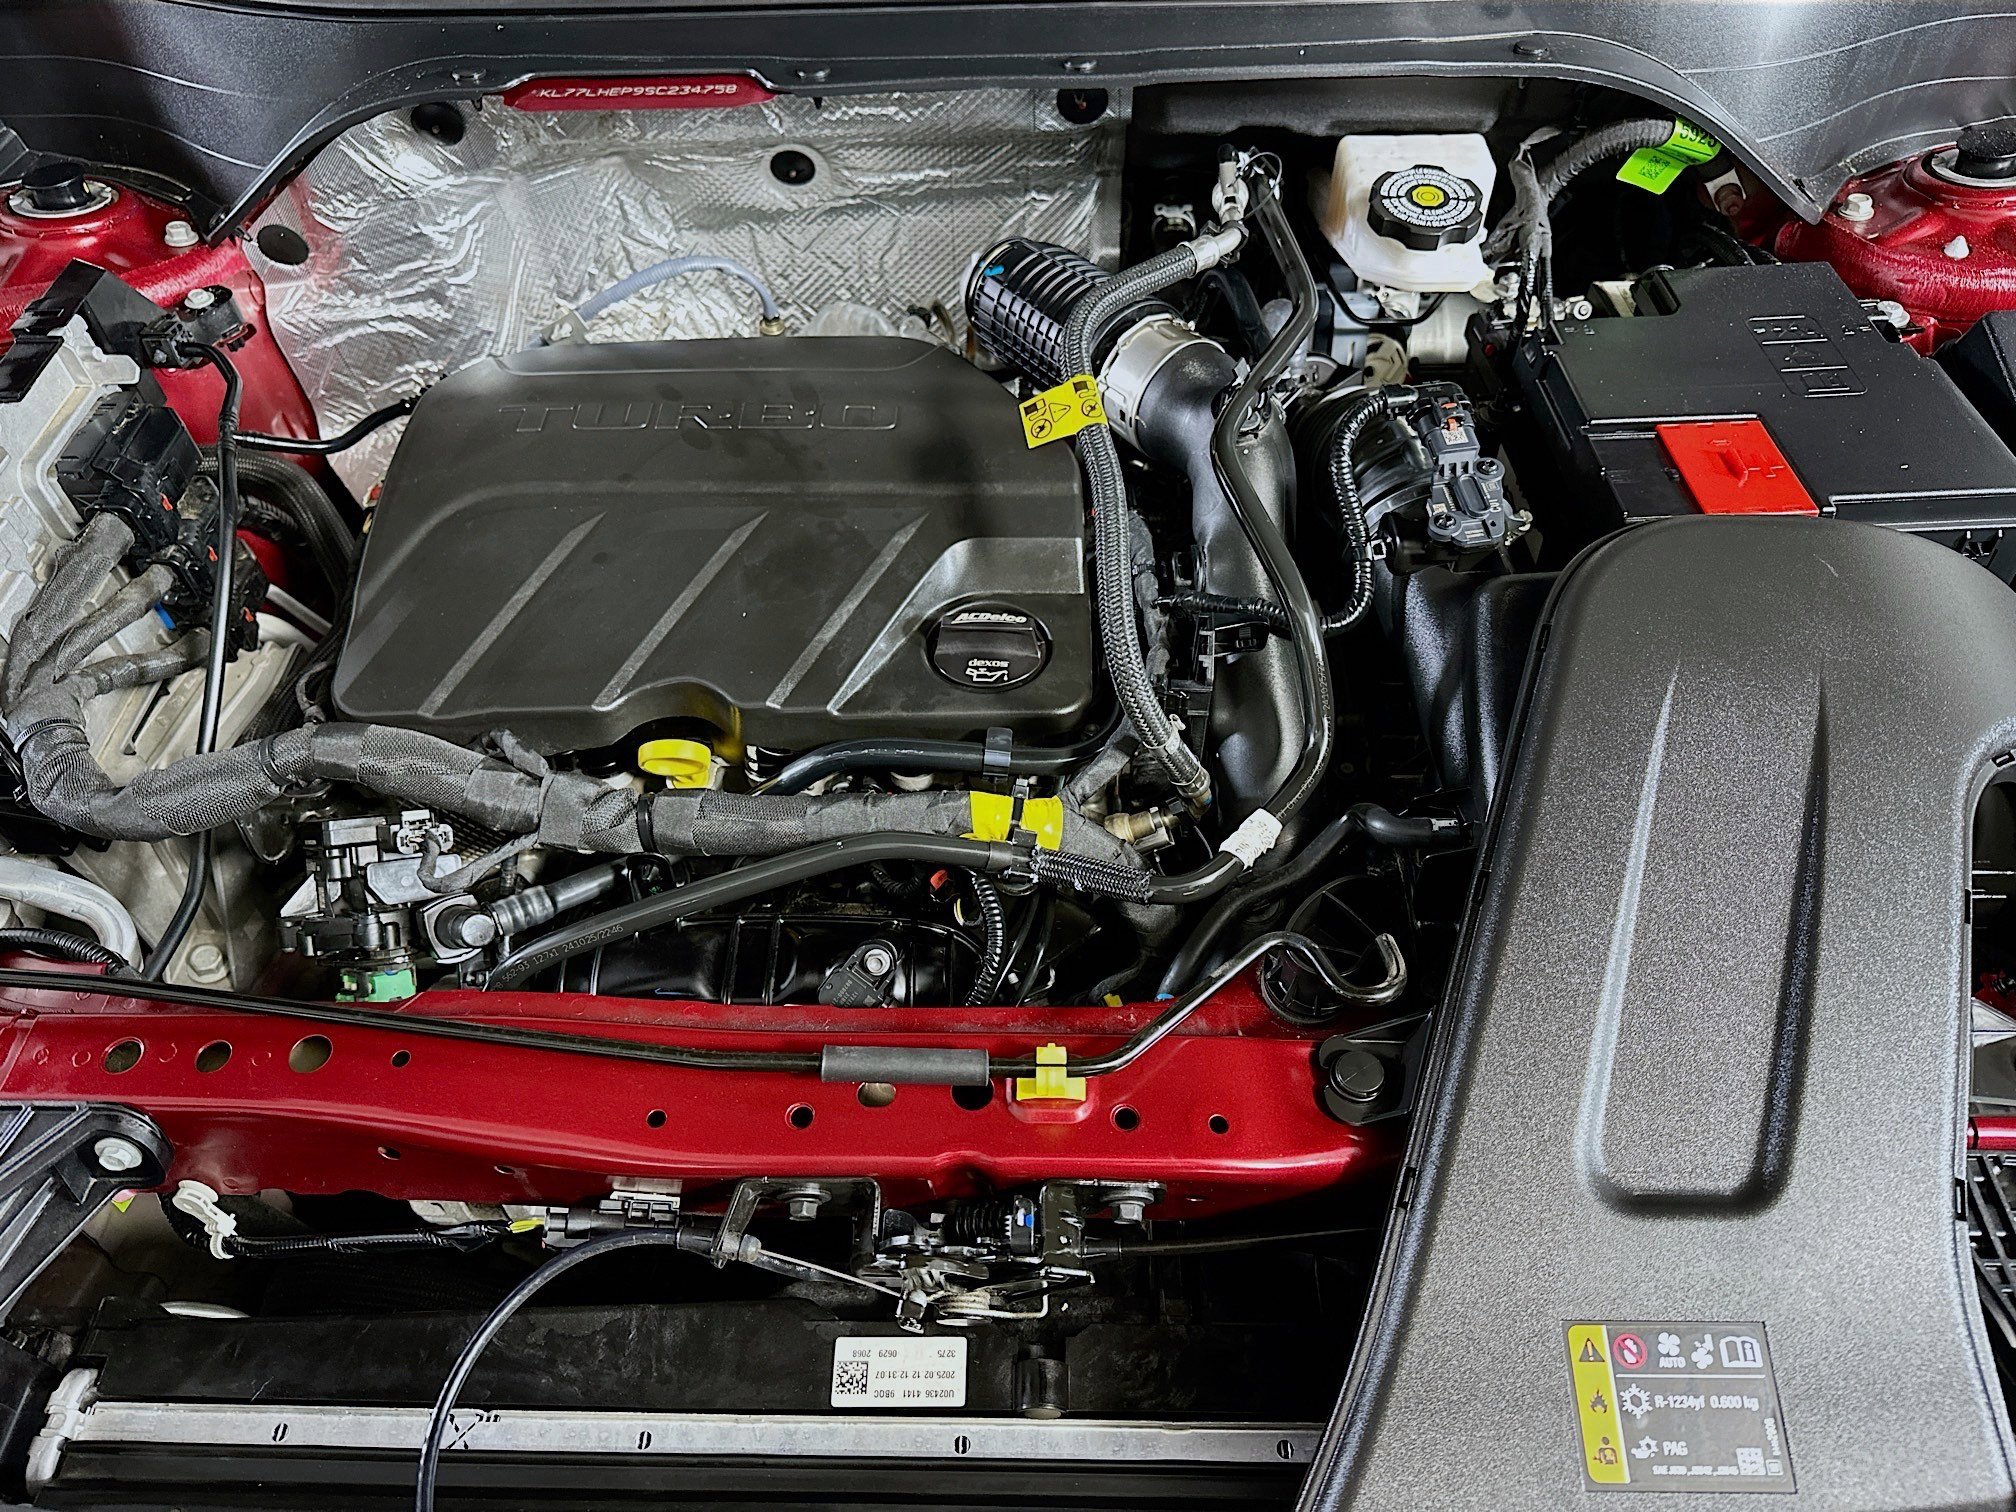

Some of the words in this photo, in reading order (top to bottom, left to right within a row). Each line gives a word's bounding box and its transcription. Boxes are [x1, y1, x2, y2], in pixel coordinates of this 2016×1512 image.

[498, 402, 899, 432] TURBO
[952, 612, 1028, 624] ACDelco
[968, 658, 1010, 668] dexos
[562, 924, 624, 953] 241025/2246
[878, 1349, 897, 1358] 0629
[937, 1349, 956, 1358] 3275
[1658, 1356, 1686, 1368] AUTO
[875, 1370, 908, 1379] 12:31:07
[911, 1370, 955, 1379] 2025.02.12
[903, 1389, 921, 1398] 4141
[925, 1389, 955, 1398] U02436
[1743, 1395, 1759, 1411] kg
[1662, 1441, 1689, 1456] PAG
